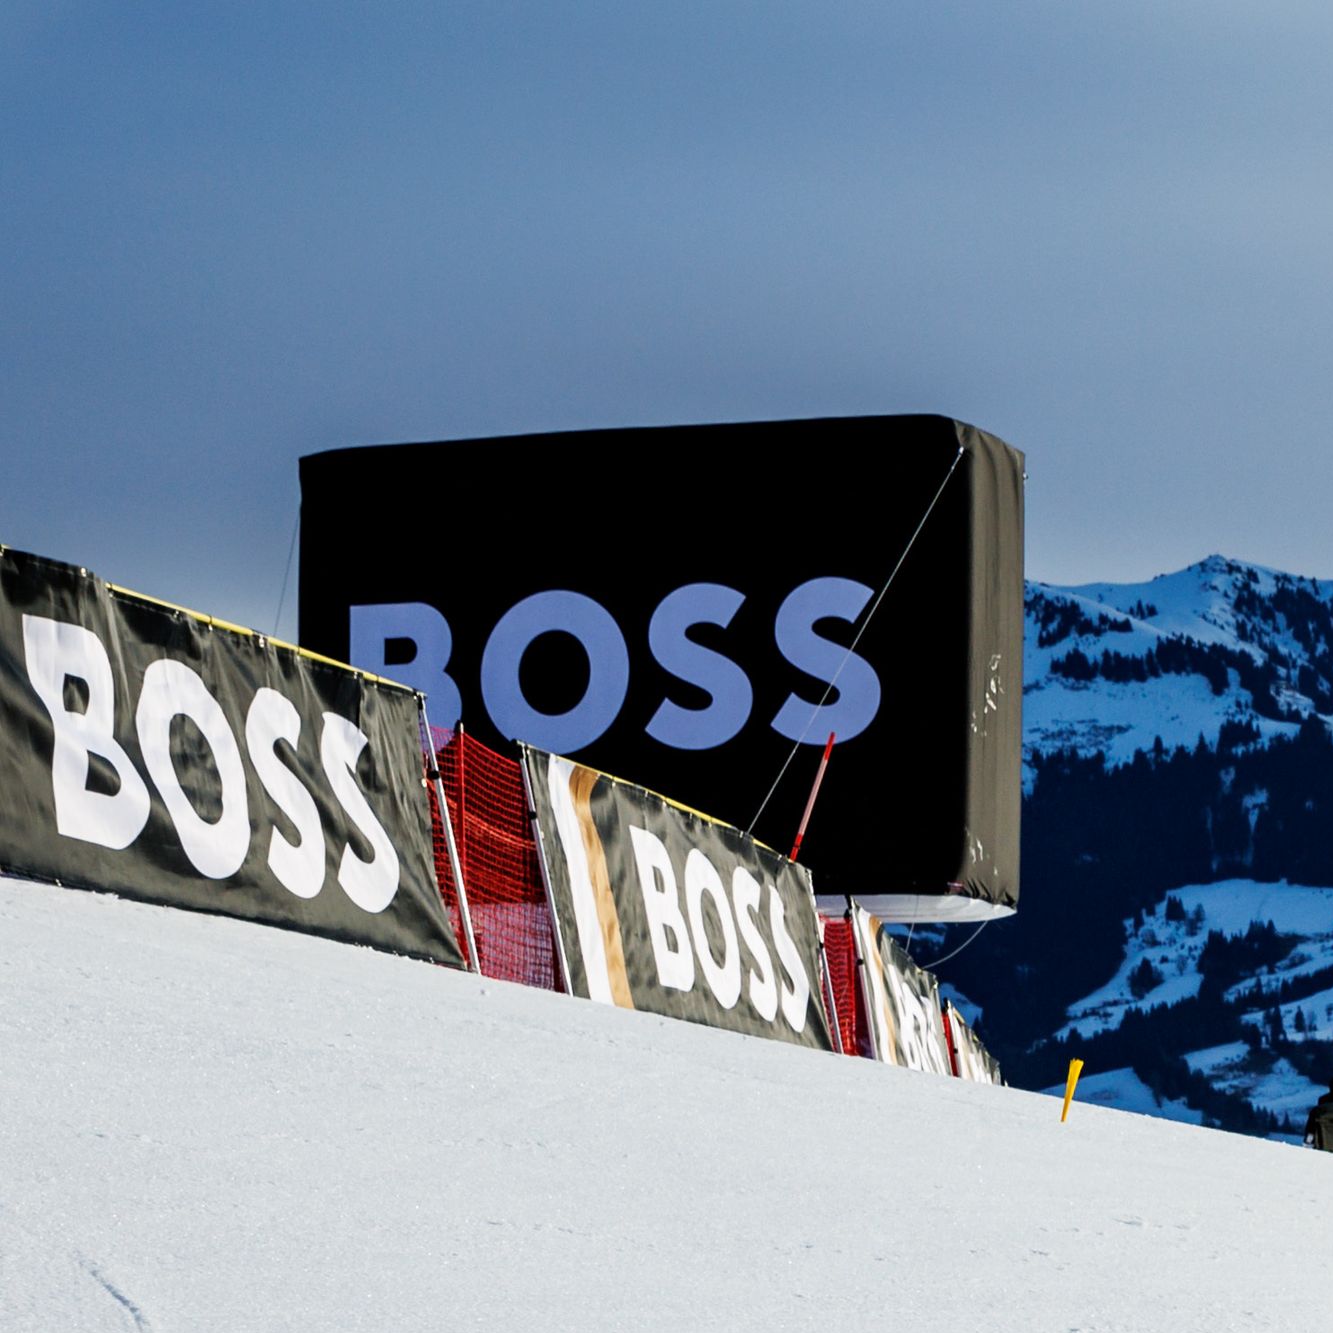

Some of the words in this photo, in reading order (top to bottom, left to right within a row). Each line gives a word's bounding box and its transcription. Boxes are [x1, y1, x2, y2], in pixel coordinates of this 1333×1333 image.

[22, 614, 401, 914] BOSS
[350, 576, 881, 754] BOSS
[629, 824, 810, 1032] BOSS
